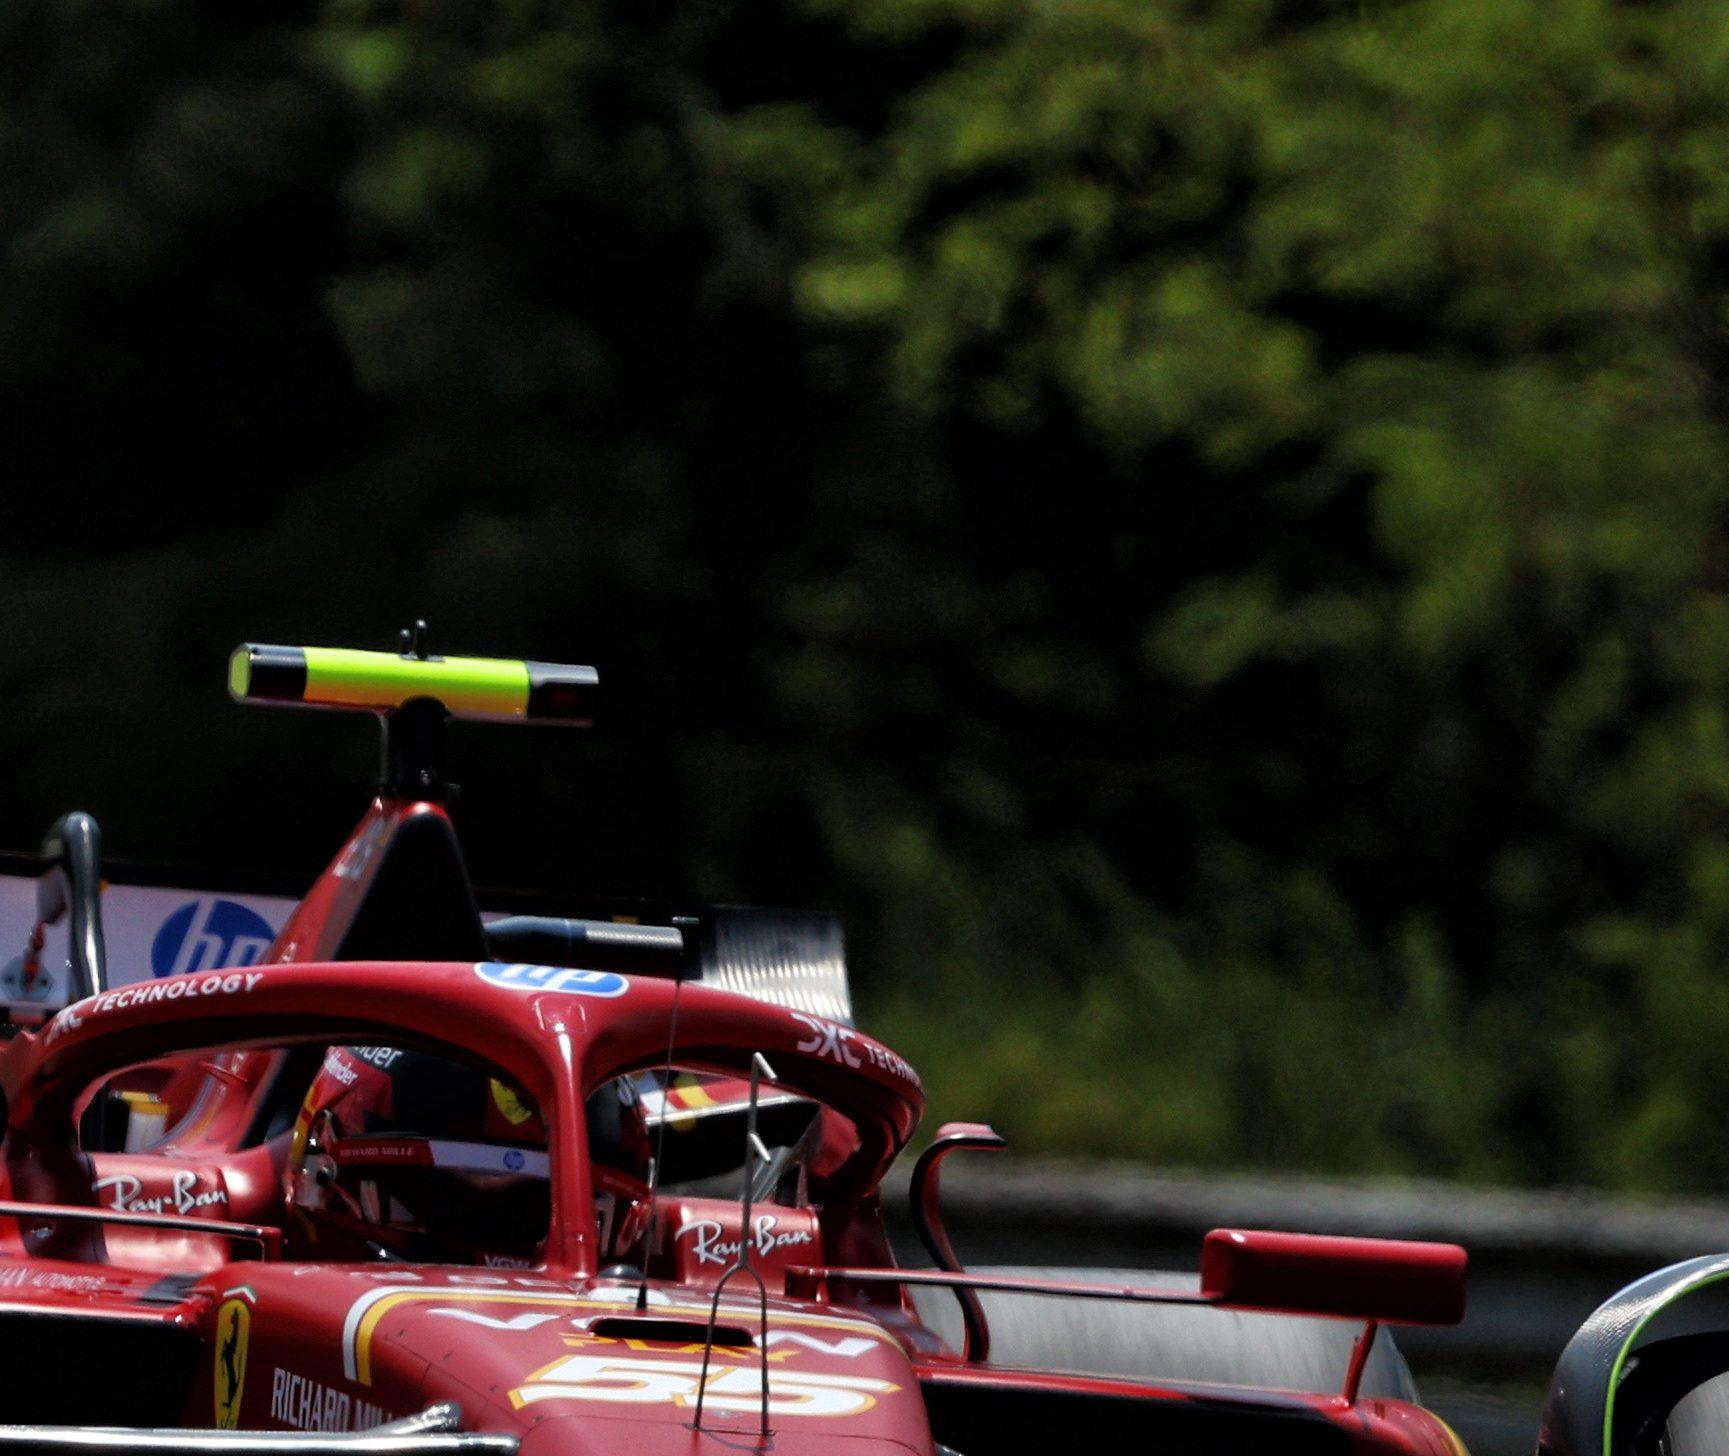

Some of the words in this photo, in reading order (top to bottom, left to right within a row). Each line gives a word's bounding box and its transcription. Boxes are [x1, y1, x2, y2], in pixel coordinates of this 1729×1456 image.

[92, 972, 265, 1013] TECHNOLOGY
[790, 1011, 863, 1069] DXC
[271, 1365, 350, 1432] RICHARD
[507, 1354, 902, 1418] 55
